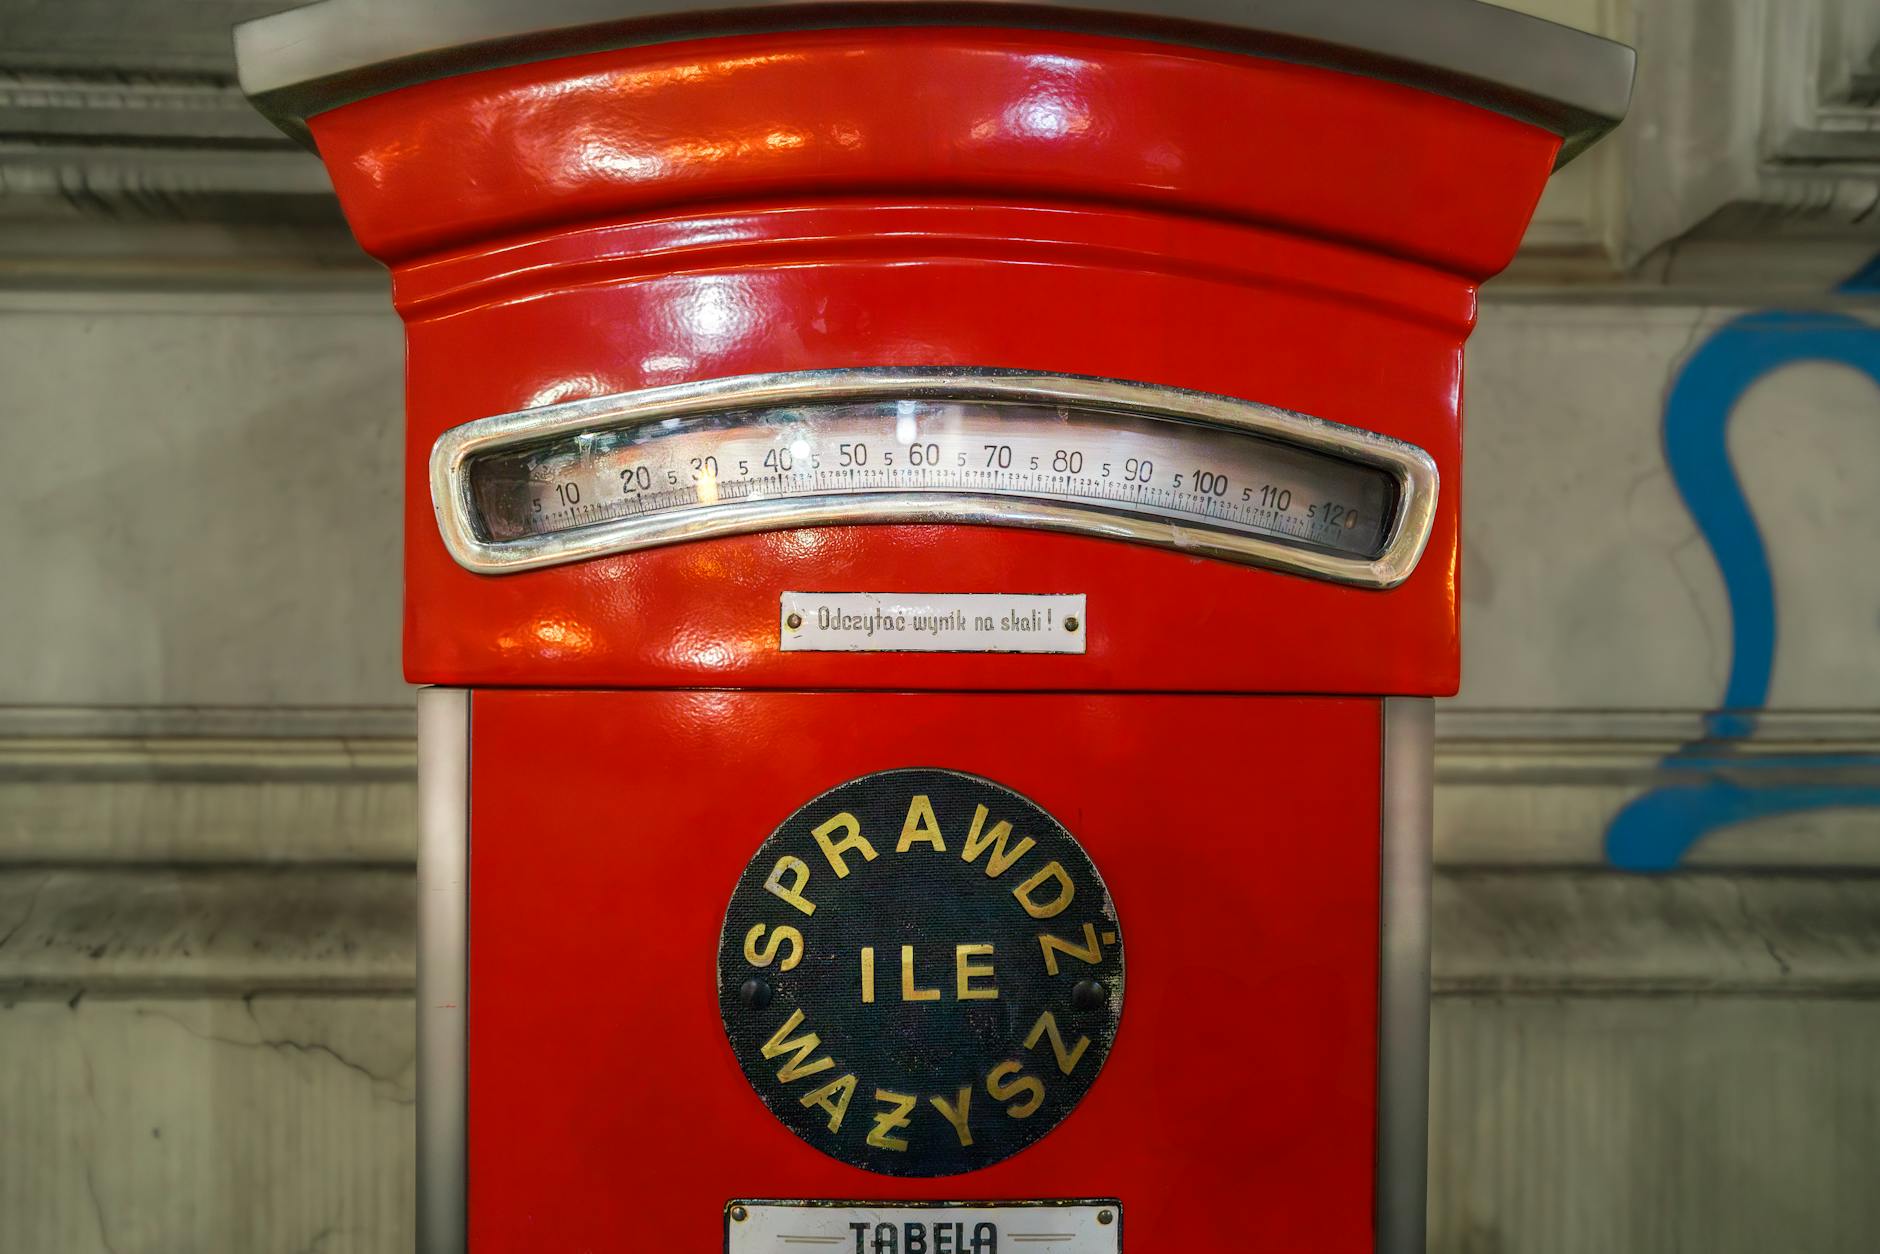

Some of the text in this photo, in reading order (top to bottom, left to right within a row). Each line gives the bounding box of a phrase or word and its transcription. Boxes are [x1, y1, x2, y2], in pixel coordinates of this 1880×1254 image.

[533, 499, 542, 513] 5
[556, 482, 581, 507] 10
[620, 466, 651, 494] 20
[667, 470, 678, 485] 5
[739, 460, 749, 475] 5
[764, 447, 793, 472] 40
[811, 453, 821, 469] 5
[840, 443, 867, 467] 50
[884, 452, 893, 466] 5
[910, 442, 940, 467] 60
[957, 452, 968, 467] 5
[984, 444, 1012, 469] 70
[1029, 456, 1039, 471] 5
[1052, 449, 1083, 474] 80
[1101, 463, 1111, 478] 5
[1124, 458, 1153, 483] 90
[1172, 473, 1183, 489] 5
[1192, 469, 1228, 497] 100
[1241, 487, 1253, 502] 5
[1260, 484, 1292, 512] 110
[1306, 504, 1317, 518] 5
[1323, 502, 1358, 529] 120
[912, 608, 967, 637] wynik
[974, 615, 995, 632] na
[1000, 608, 1042, 632] skali
[860, 943, 999, 1003] ILE
[848, 1221, 999, 1254] TABELA
